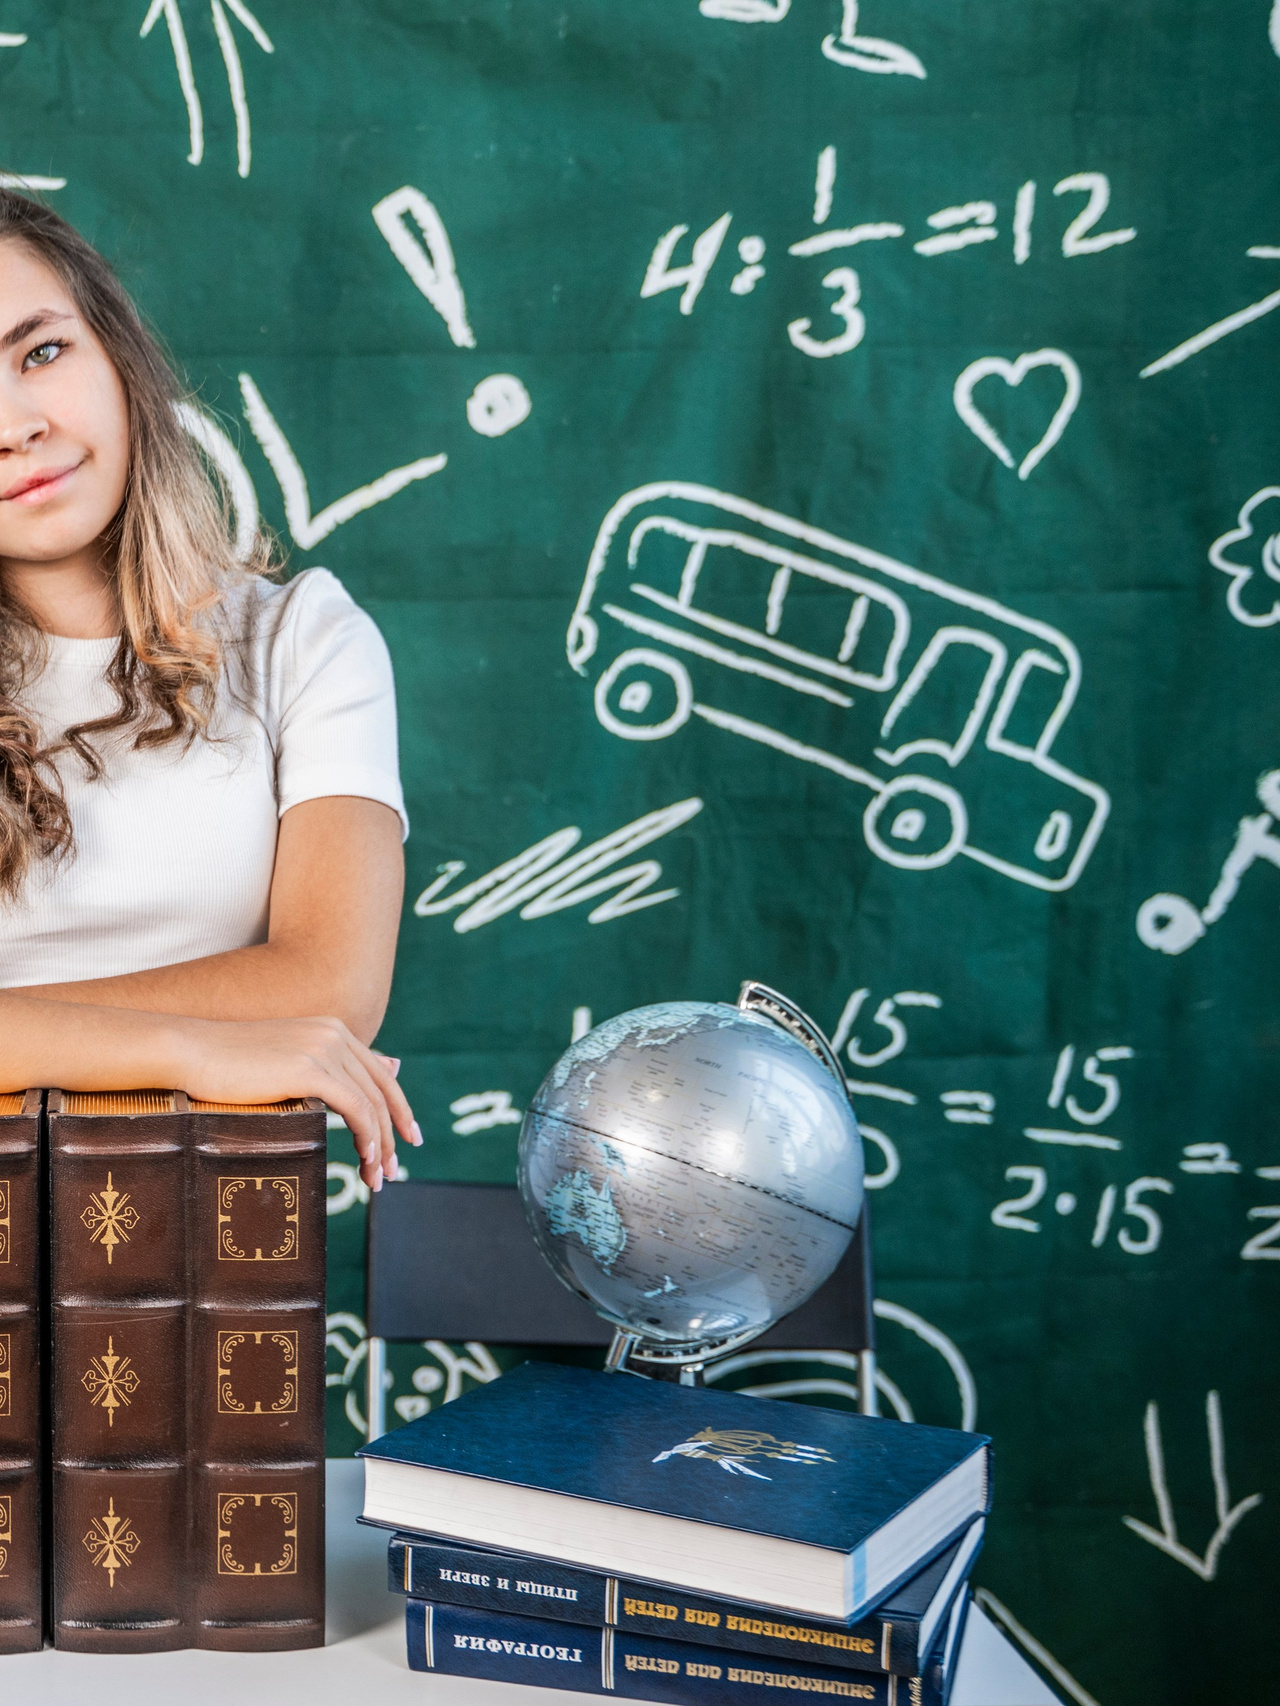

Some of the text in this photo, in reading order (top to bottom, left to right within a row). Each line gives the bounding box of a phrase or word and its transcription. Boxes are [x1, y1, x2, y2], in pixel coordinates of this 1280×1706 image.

[788, 268, 864, 357] 3
[1049, 1047, 1129, 1123] 15
[439, 1568, 578, 1601] ПТИЦЫ И ЗВЕРИ
[453, 1634, 583, 1663] ГЕОГРАФИЯ
[624, 1597, 875, 1654] ЭНЦИКЛОПЕДИЯ ДЛЯ ДЕТЕЙ
[624, 1654, 876, 1700] ЭНЦИКЛОПЕДИЯ ДЛЯ ДЕТЕЙ
